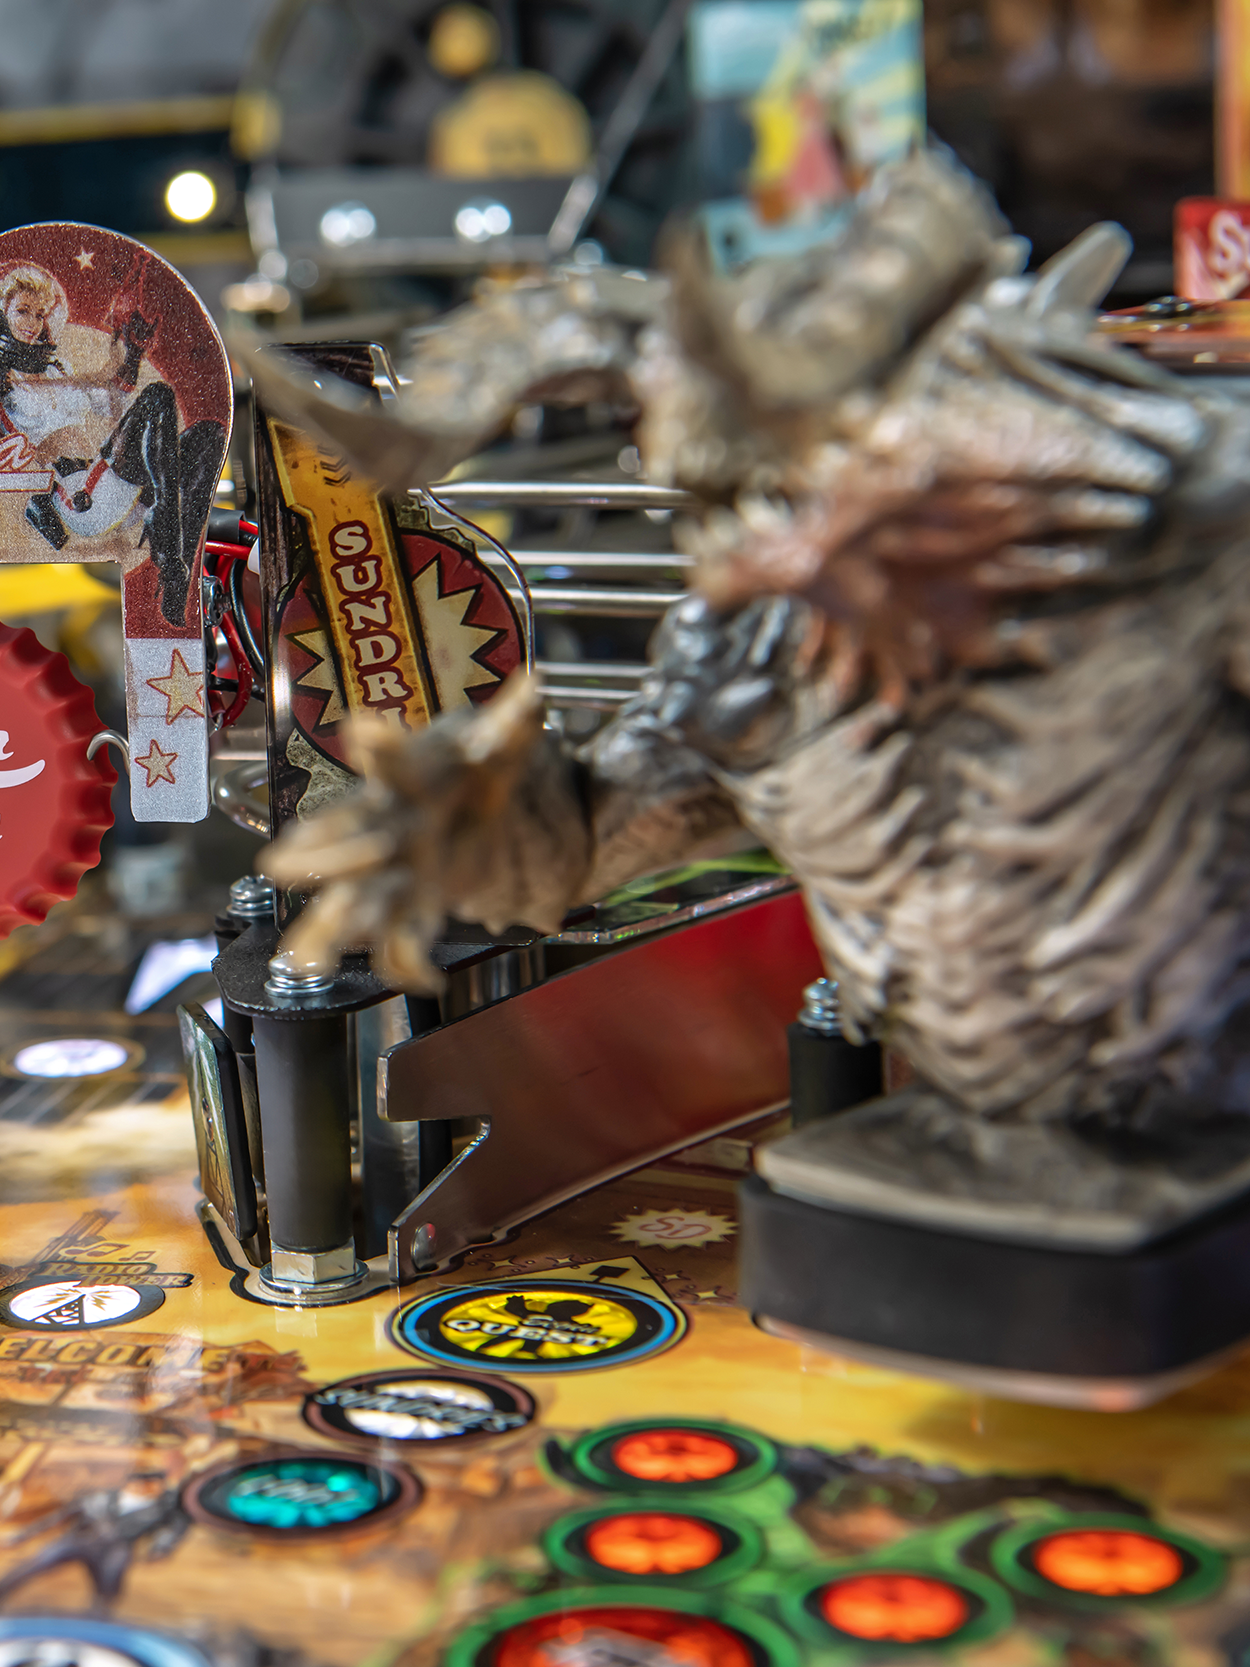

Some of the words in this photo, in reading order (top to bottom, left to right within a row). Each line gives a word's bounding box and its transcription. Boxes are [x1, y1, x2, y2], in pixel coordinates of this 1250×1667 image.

[44, 1262, 150, 1277] RADIO
[80, 1273, 185, 1288] TOWER
[446, 1318, 608, 1347] QUEST
